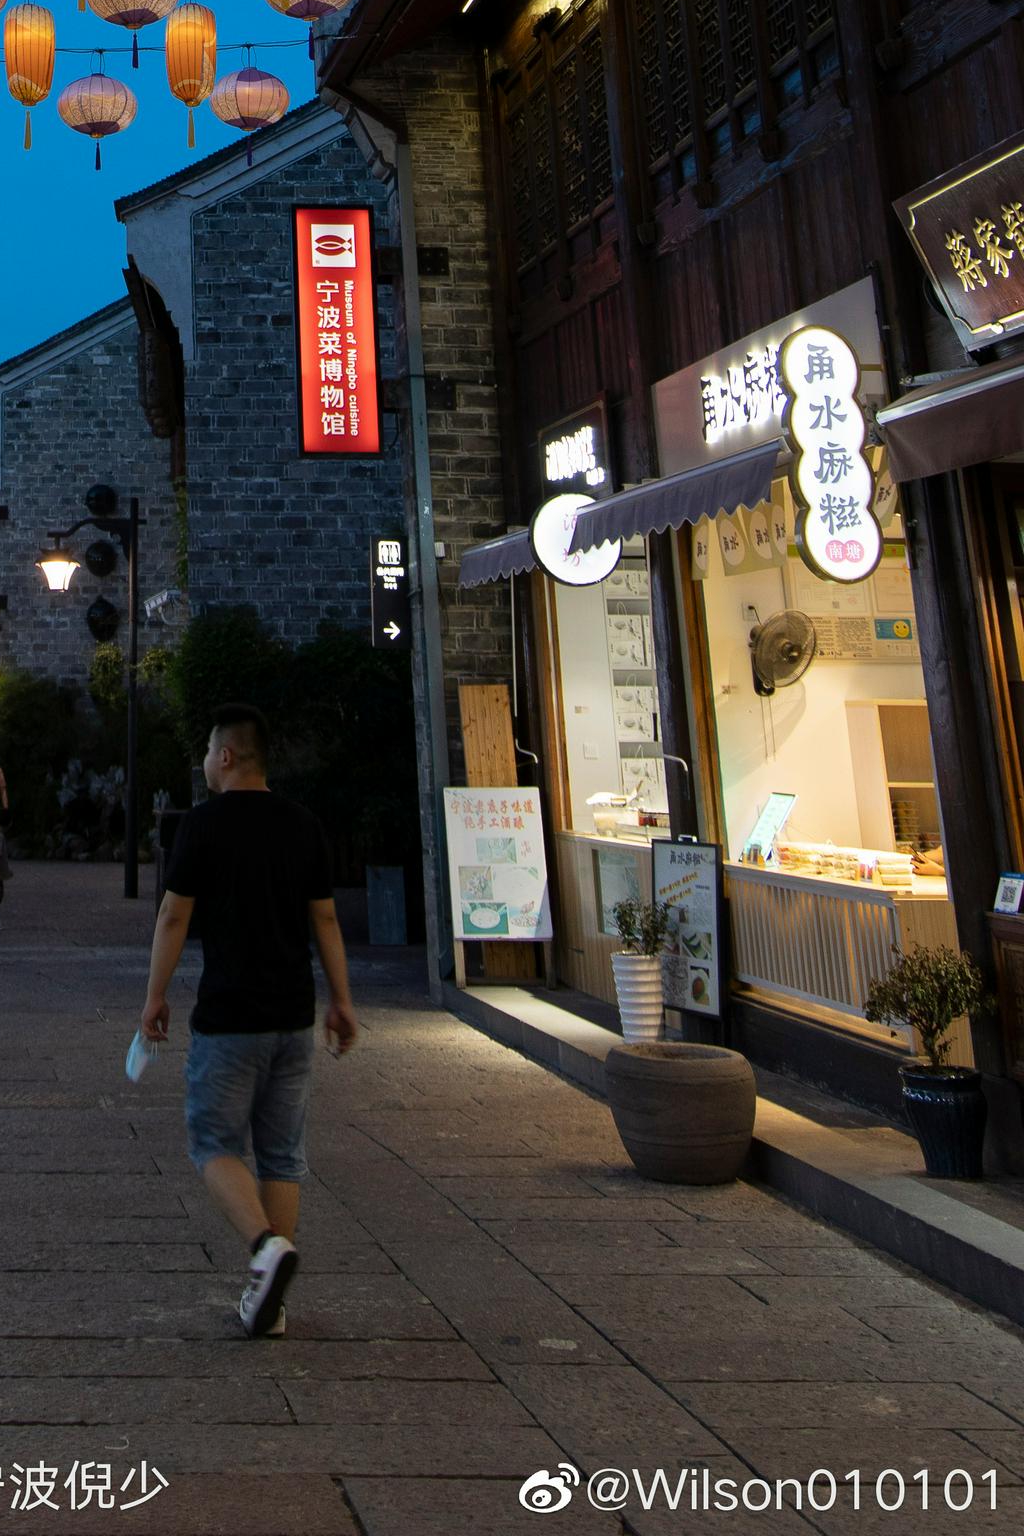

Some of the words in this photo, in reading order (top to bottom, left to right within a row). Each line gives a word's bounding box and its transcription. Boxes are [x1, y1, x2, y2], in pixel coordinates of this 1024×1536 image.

[344, 280, 354, 327] Museum
[316, 280, 345, 436] 宁波菜博物馆
[346, 332, 356, 344] of
[346, 349, 356, 390] Ningbo
[349, 395, 358, 436] cuisine
[804, 343, 862, 536] 甬水麻糍
[828, 541, 862, 560] 南塘
